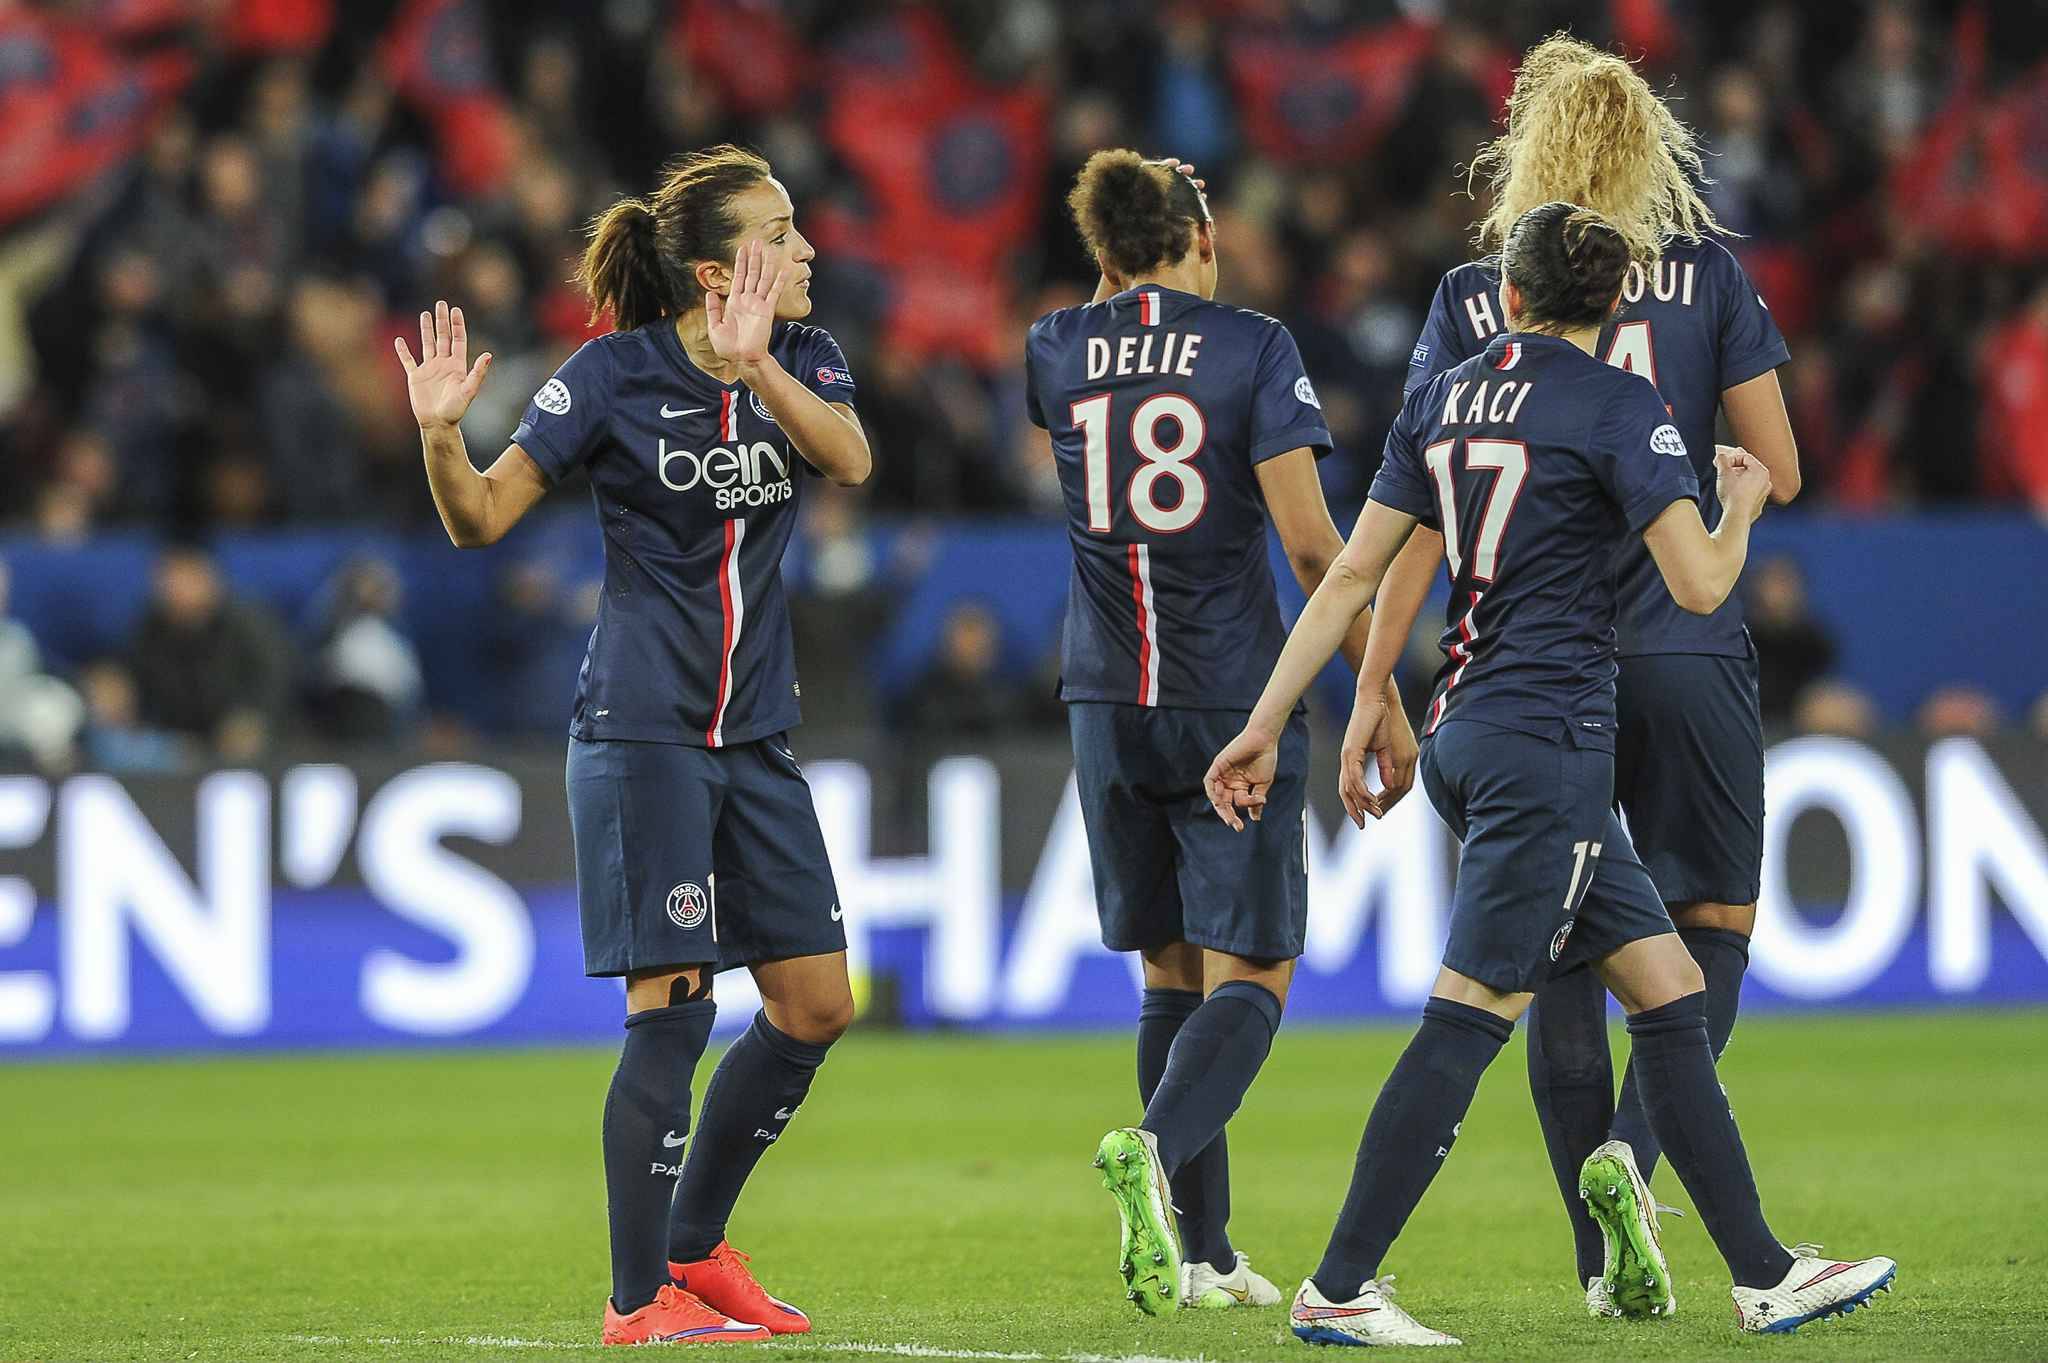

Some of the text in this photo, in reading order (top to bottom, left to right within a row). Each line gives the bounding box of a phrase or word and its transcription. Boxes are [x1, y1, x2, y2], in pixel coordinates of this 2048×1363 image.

[1463, 260, 1695, 340] HOUI
[1086, 332, 1203, 381] DELIE
[1441, 381, 1533, 426] KACI
[1070, 391, 1209, 534] 18
[714, 478, 793, 511] SPORTS
[1424, 437, 1531, 584] 17
[673, 886, 701, 899] PARIS
